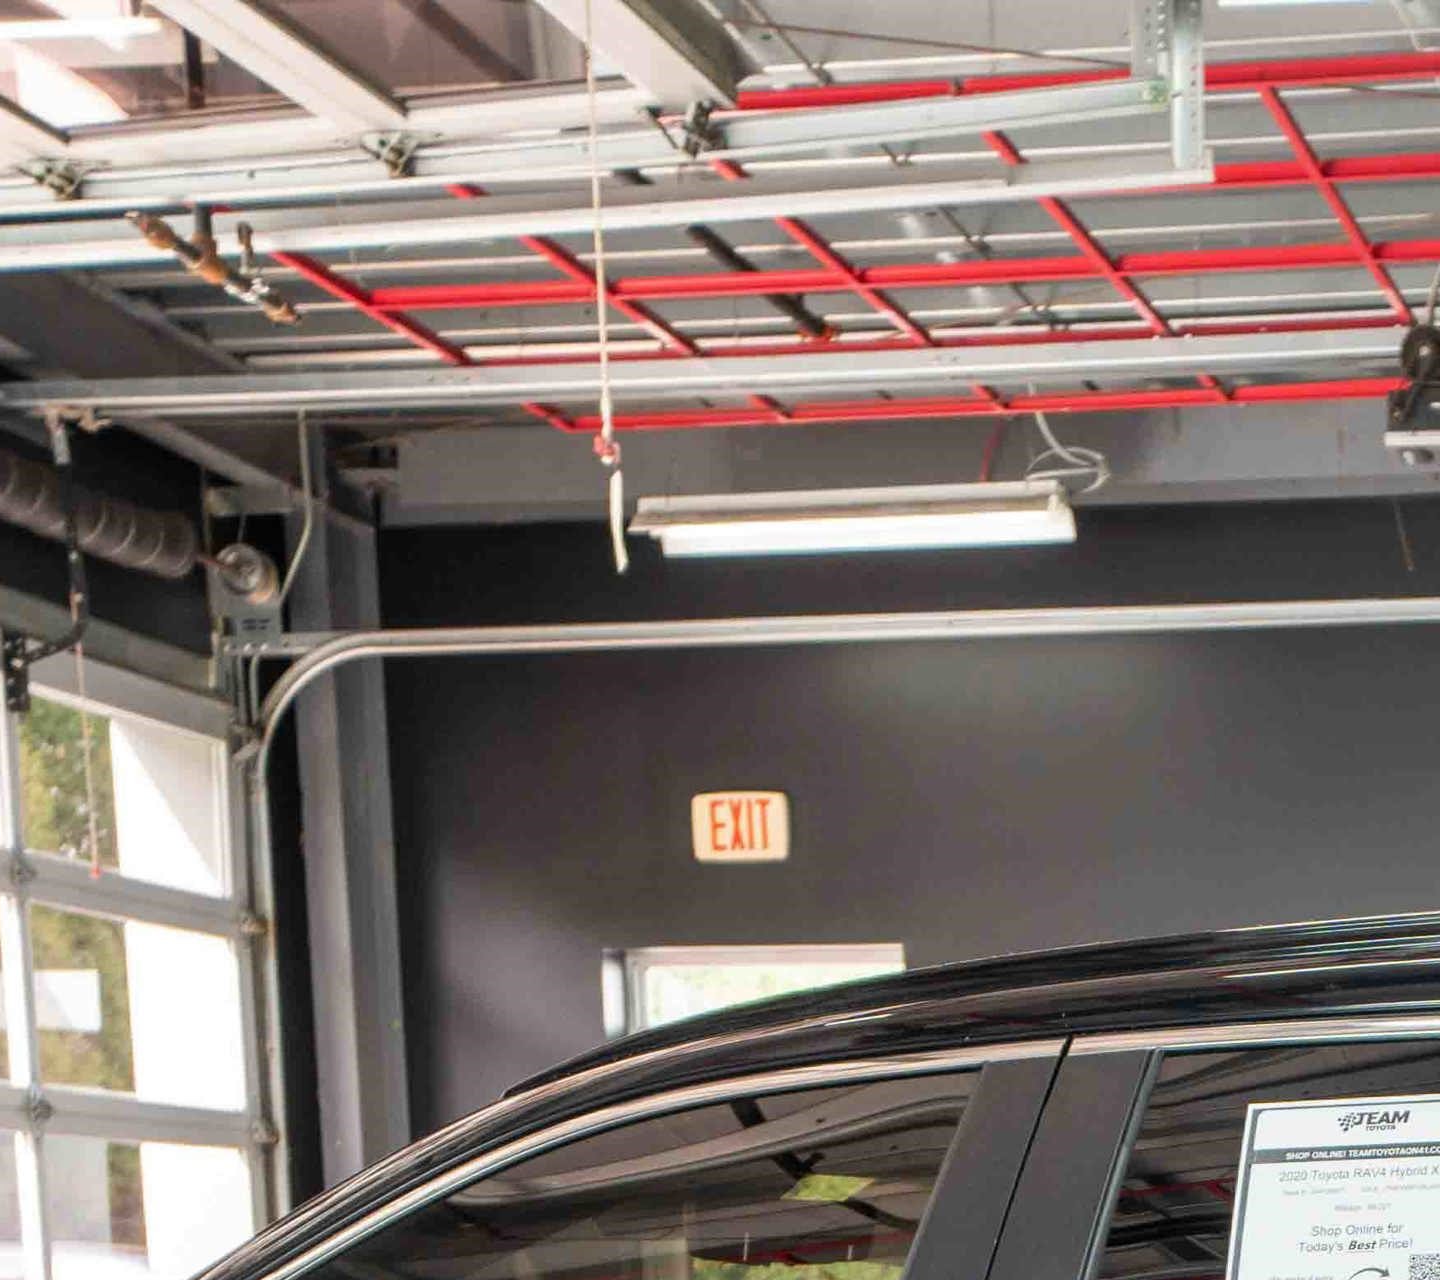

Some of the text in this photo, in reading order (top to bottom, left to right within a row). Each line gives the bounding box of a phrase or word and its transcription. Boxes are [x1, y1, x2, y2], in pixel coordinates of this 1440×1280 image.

[709, 799, 771, 851] EXIT
[1354, 1110, 1410, 1126] TEAM
[1365, 1124, 1396, 1133] TOYOTA
[1285, 1150, 1311, 1161] SHOP
[1279, 1170, 1308, 1183] 2020
[1312, 1168, 1350, 1182] Toyota
[1353, 1167, 1386, 1179] RAV4
[1390, 1165, 1428, 1179] Hybrid
[1311, 1222, 1404, 1238] Shop Online for
[1297, 1238, 1414, 1254] Today's Best Price!
